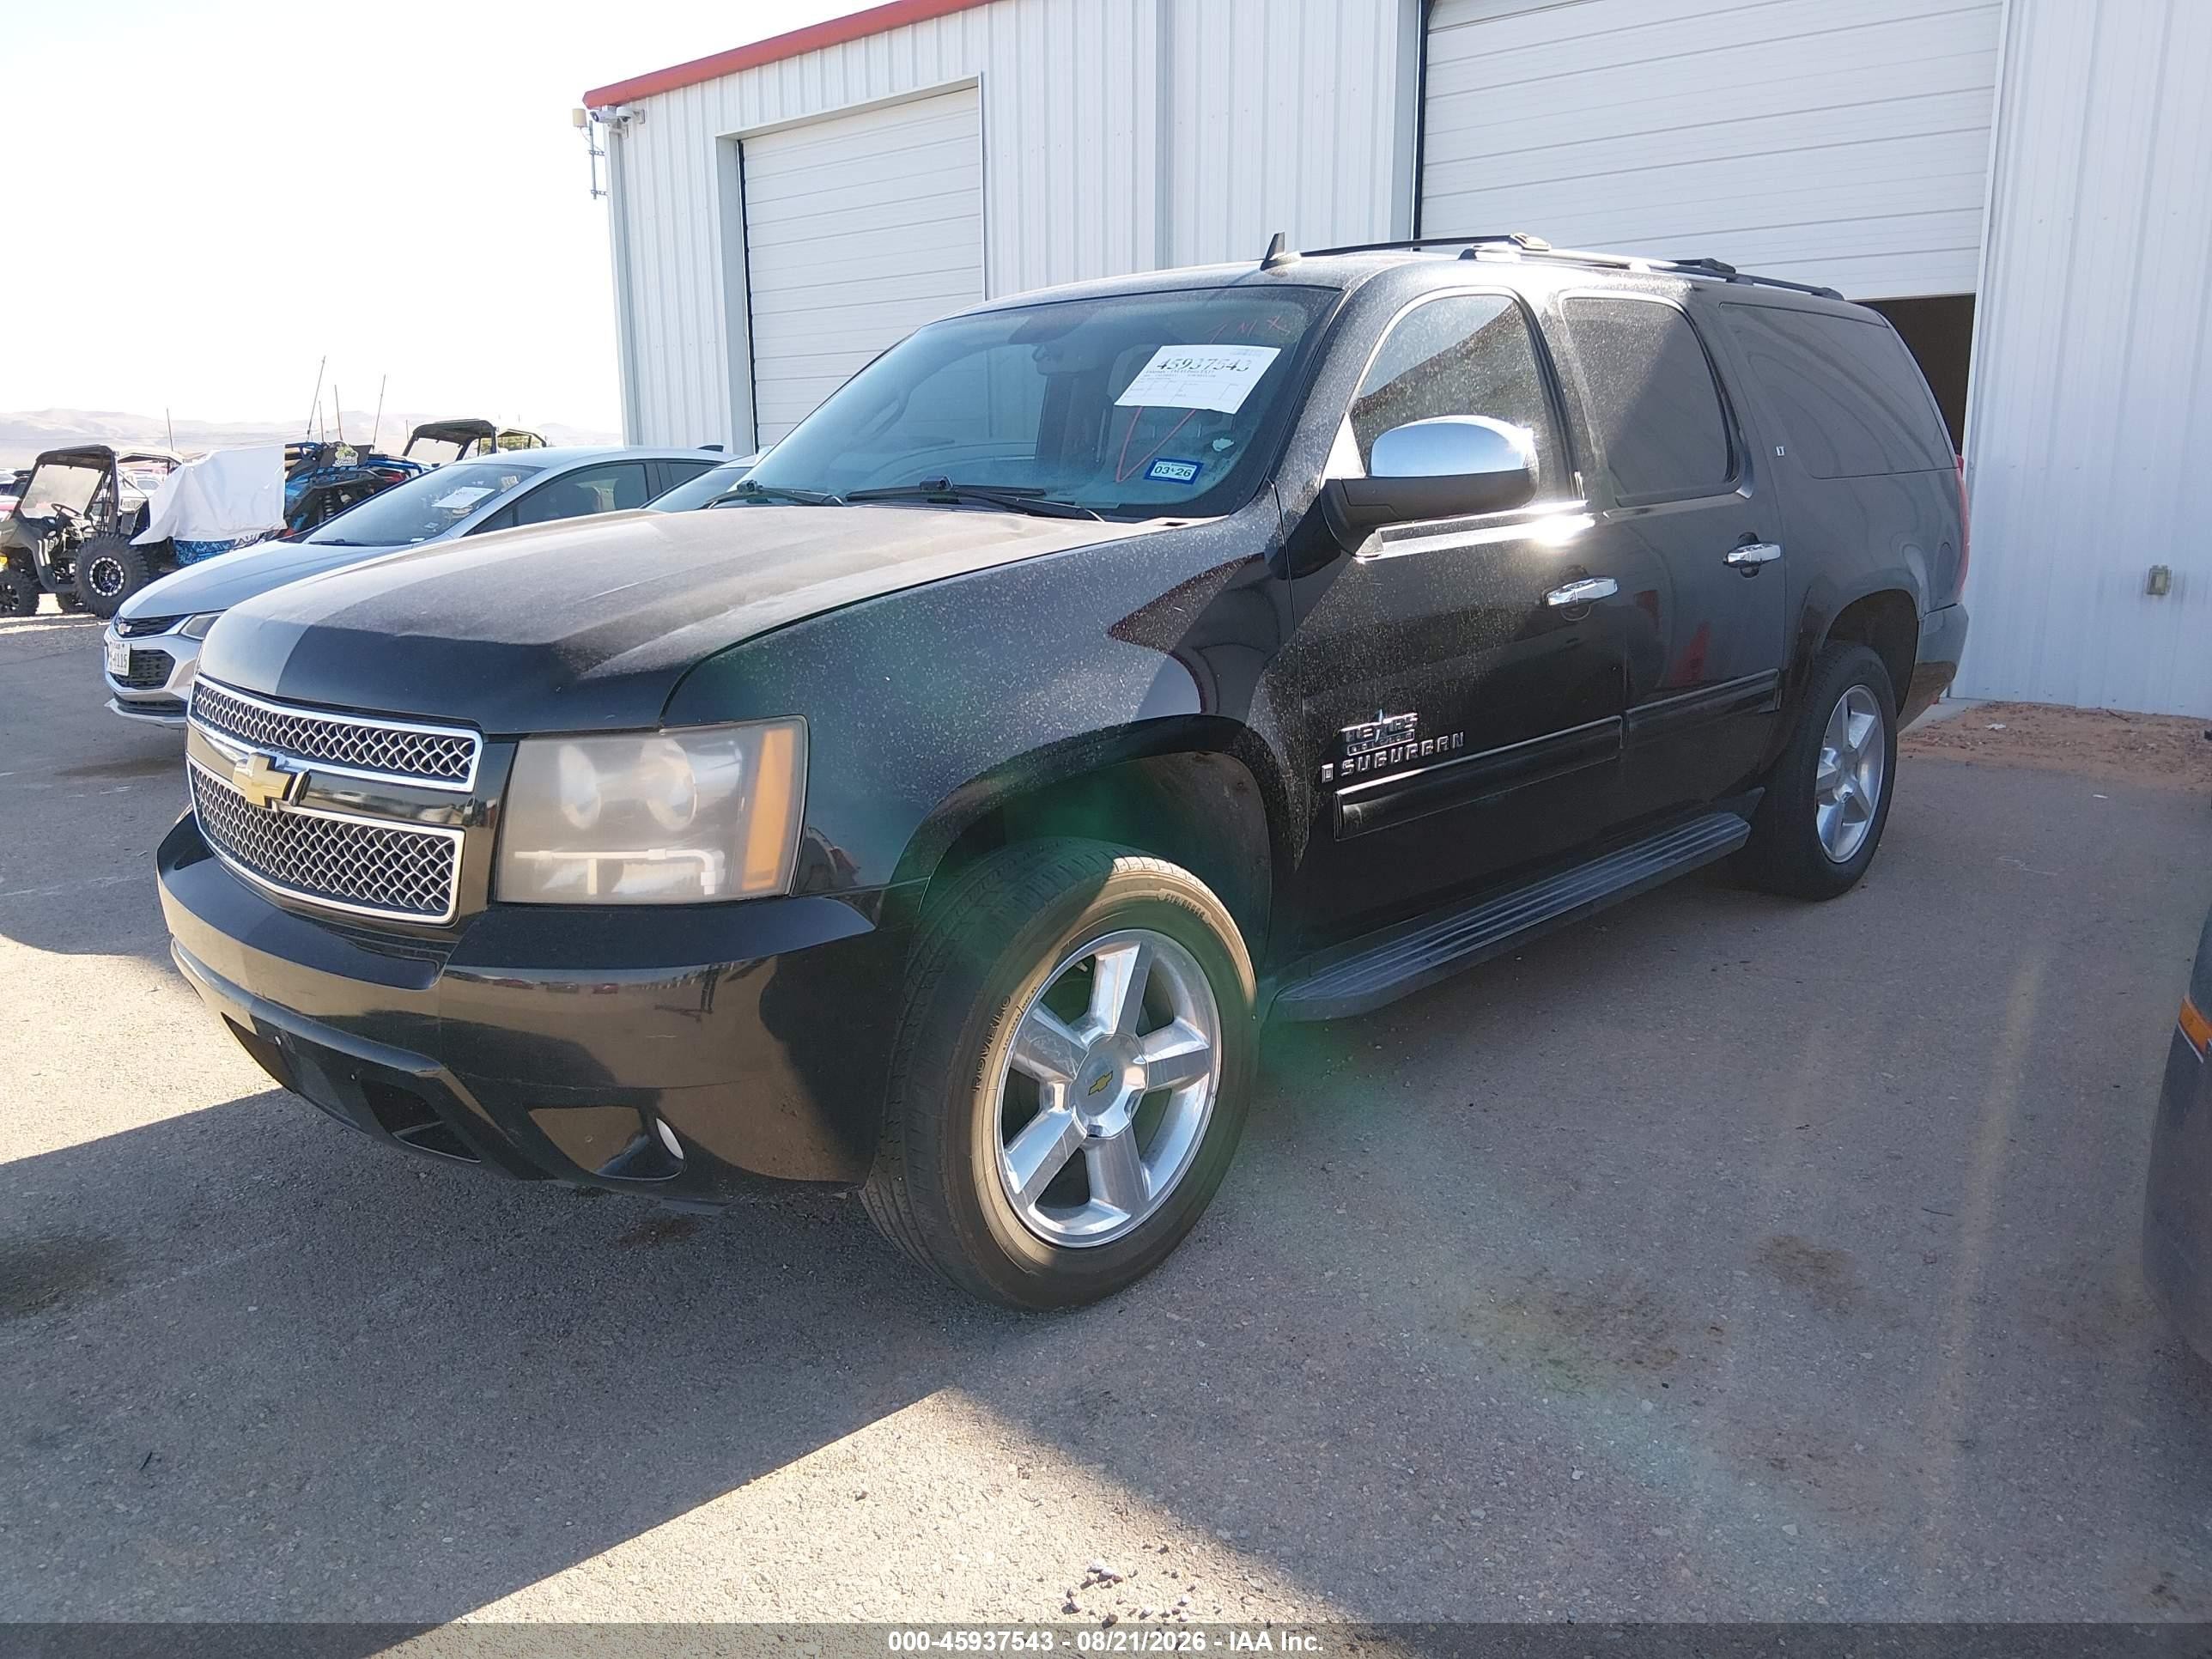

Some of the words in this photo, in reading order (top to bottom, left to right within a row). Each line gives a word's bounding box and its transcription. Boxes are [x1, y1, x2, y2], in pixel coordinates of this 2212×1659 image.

[1157, 357, 1252, 372] 45937543
[1154, 466, 1170, 475] 03
[1175, 468, 1193, 477] 26
[1340, 732, 1464, 777] SUBURBAN
